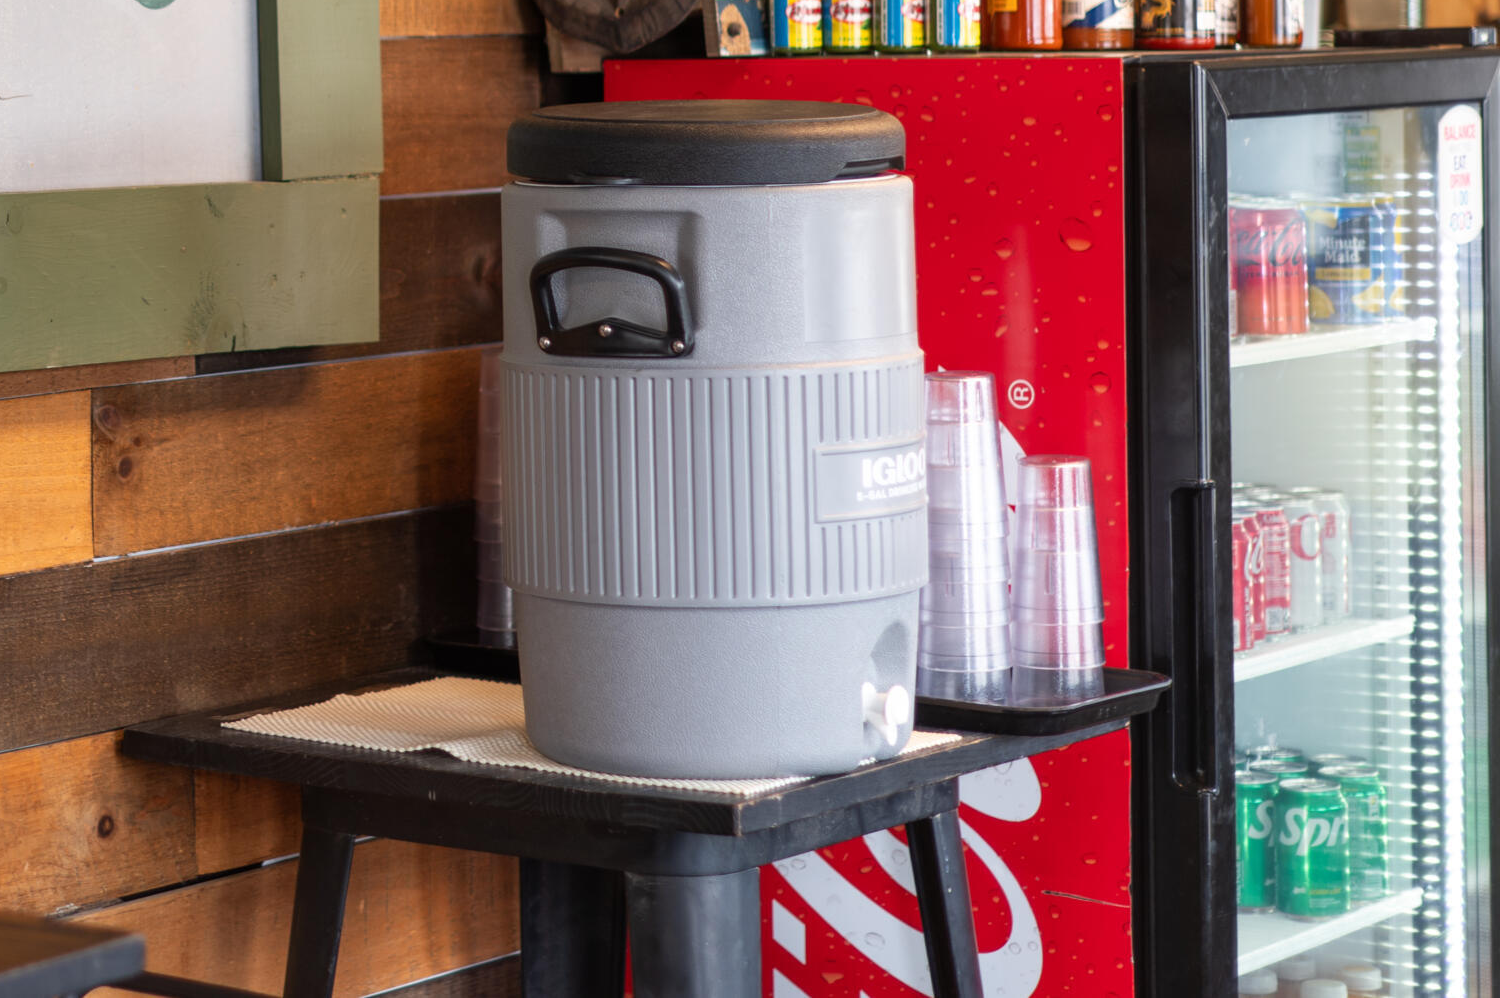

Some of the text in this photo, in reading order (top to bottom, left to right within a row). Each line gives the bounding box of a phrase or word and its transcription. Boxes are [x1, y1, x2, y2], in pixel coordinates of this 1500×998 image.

[1318, 236, 1366, 252] Minute
[1324, 251, 1362, 265] Maid
[861, 448, 926, 489] IGLOO
